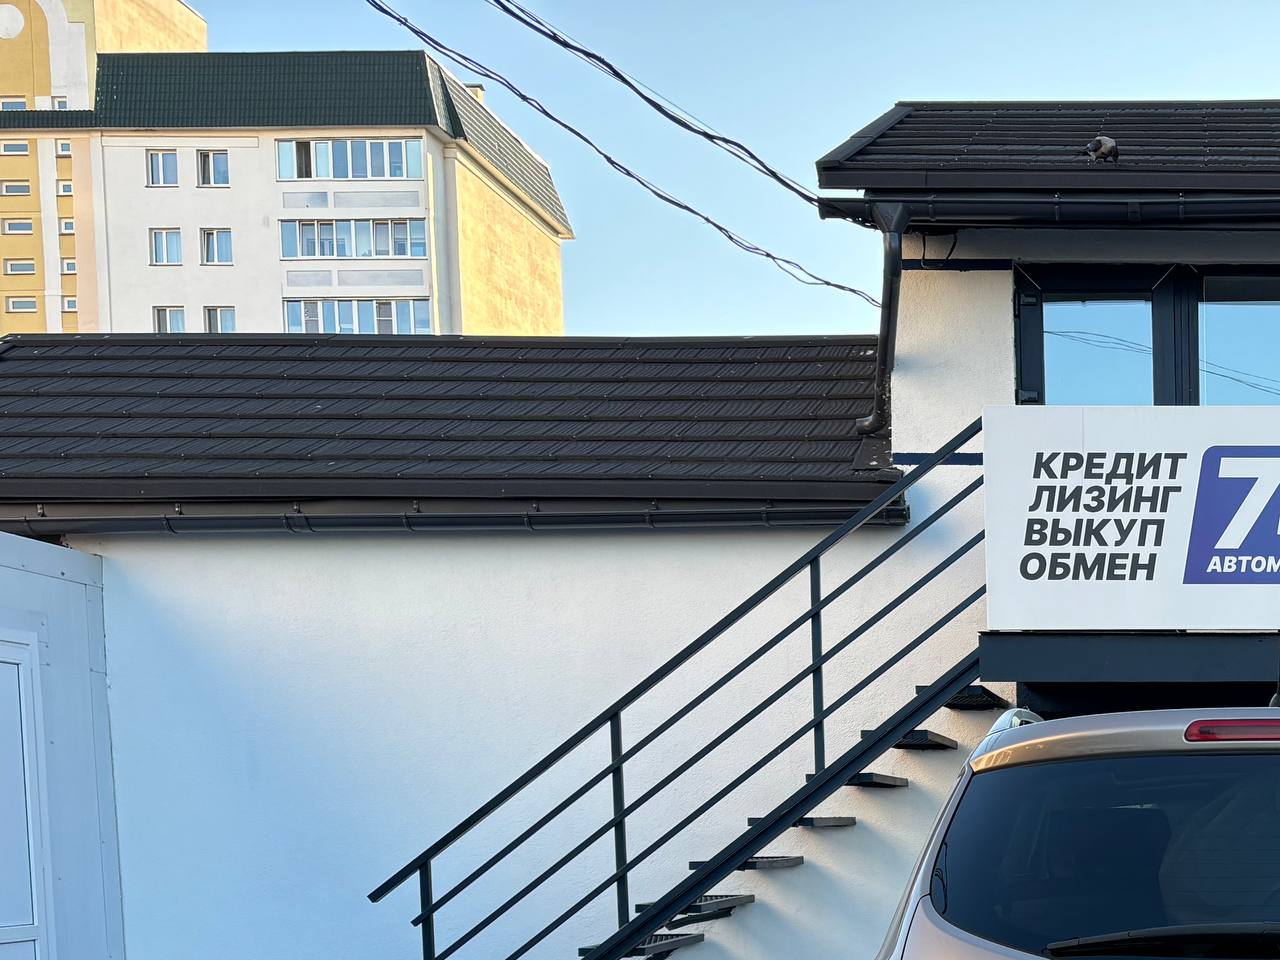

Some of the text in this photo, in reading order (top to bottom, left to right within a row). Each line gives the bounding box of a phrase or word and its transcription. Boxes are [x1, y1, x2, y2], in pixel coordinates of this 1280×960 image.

[1032, 452, 1188, 485] КРЕДИТ
[1028, 485, 1182, 513] ЛИЗИНГ
[1023, 518, 1166, 547] ВЫКУП
[1019, 552, 1158, 581] ОБМЕН
